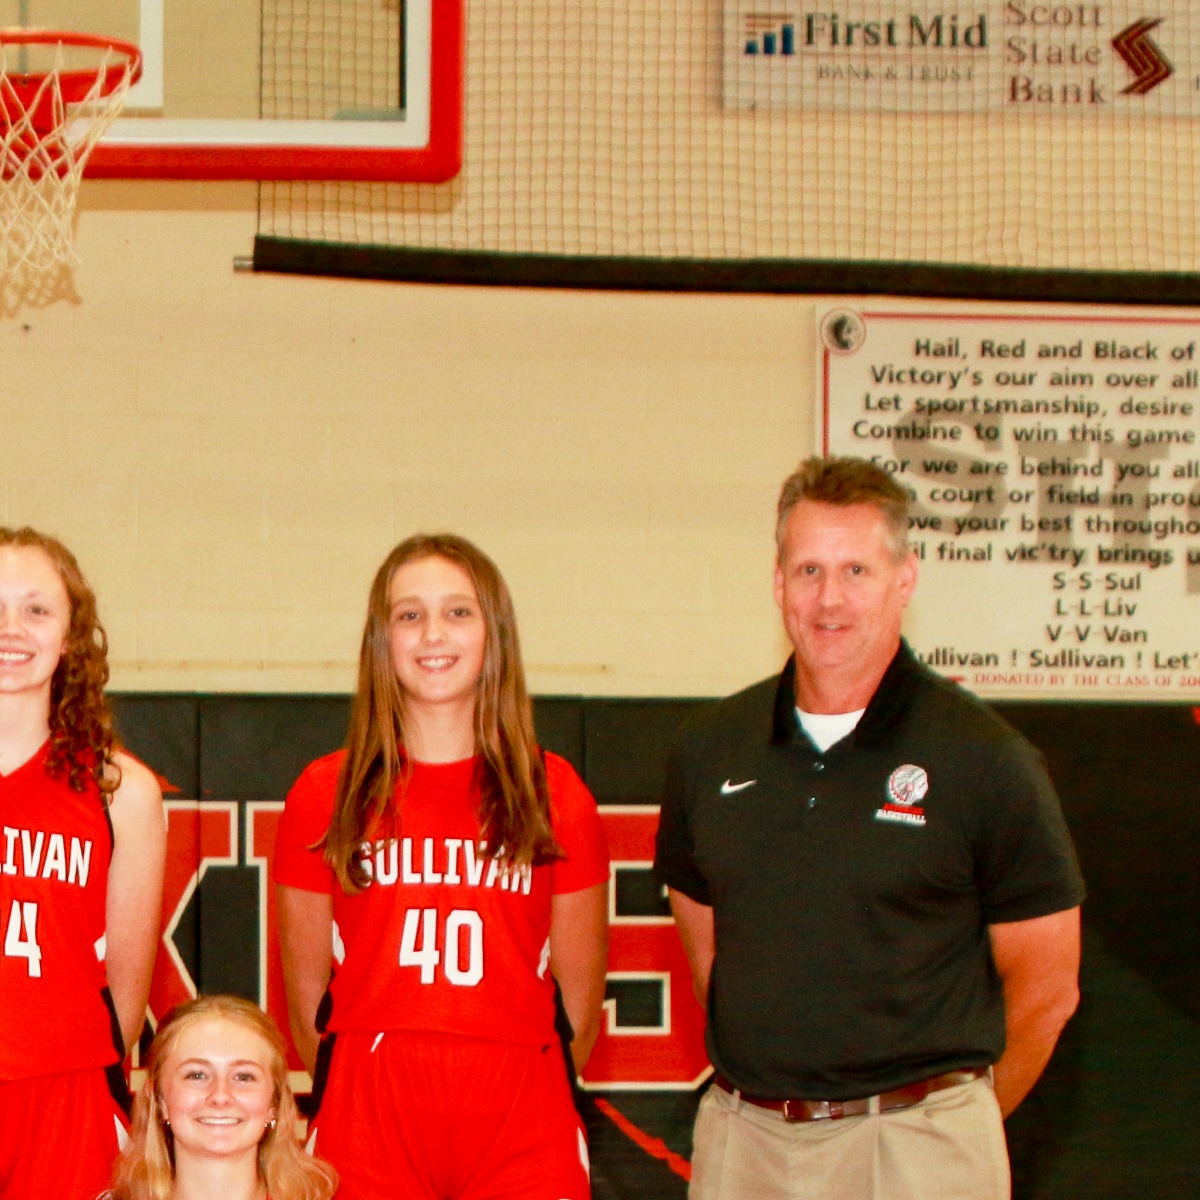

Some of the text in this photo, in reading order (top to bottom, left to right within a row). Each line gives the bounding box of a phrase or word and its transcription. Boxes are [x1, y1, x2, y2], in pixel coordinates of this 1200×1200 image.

[1007, 0, 1102, 27] Scott
[805, 13, 987, 48] First Mid
[1007, 36, 1102, 64] State
[1009, 74, 1104, 103] Bank
[915, 338, 1195, 361] Hail, Red and Black of
[870, 365, 1198, 389] Victory's our aim over all
[865, 393, 1193, 417] Let sportsmanship, desire
[853, 420, 1195, 448] Combine to win this game
[923, 460, 958, 473] we
[970, 459, 1009, 475] are
[1021, 457, 1103, 477] behind
[1116, 462, 1160, 481] you
[1173, 460, 1200, 477] all
[930, 486, 995, 502] court
[1009, 488, 1034, 502] or
[1047, 484, 1100, 504] field
[1112, 484, 1133, 505] in
[955, 517, 1009, 535] your
[1021, 514, 1073, 531] best
[938, 543, 992, 561] final
[1005, 544, 1086, 567] vic'try
[1097, 543, 1174, 568] brings
[918, 647, 998, 667] ullivan
[1029, 648, 1125, 668] Sullivan
[974, 673, 1045, 686] DONATED
[1050, 673, 1066, 686] BY
[1074, 673, 1098, 686] THE
[399, 908, 484, 986] 40
